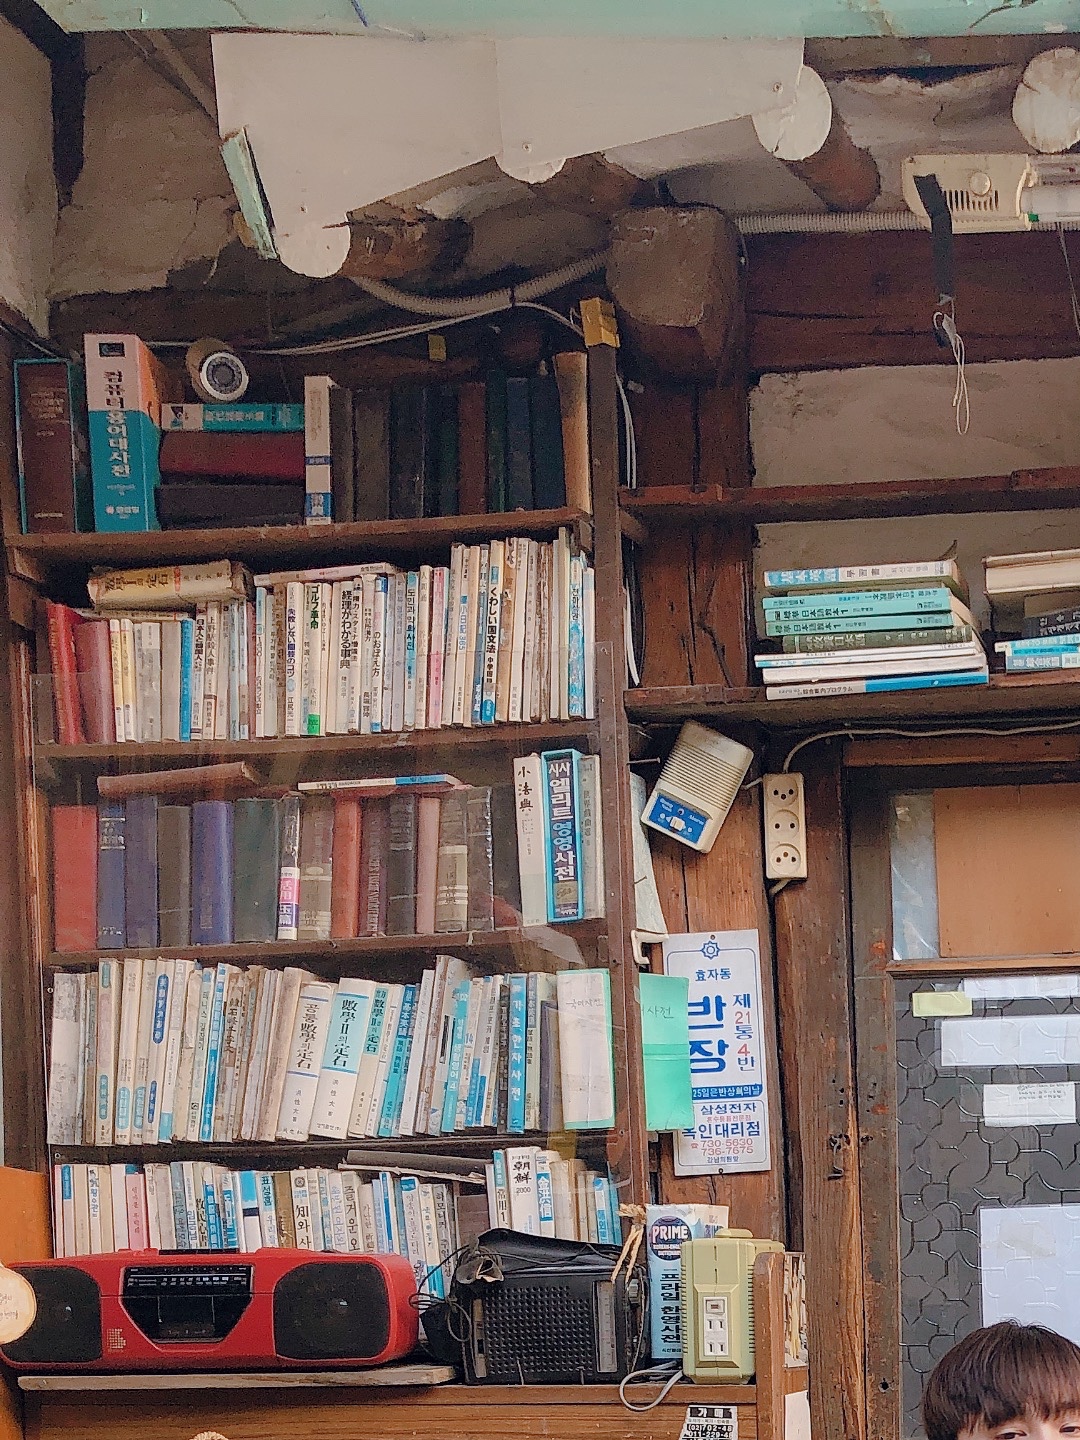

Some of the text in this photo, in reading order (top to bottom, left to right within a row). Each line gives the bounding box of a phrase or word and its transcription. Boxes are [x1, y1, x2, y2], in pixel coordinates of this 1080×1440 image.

[695, 968, 731, 982] 효자동
[700, 1102, 757, 1116] 삼성전자
[513, 1160, 532, 1185] 朝鮮
[515, 1186, 531, 1194] 2000
[652, 1224, 689, 1243] PRIME
